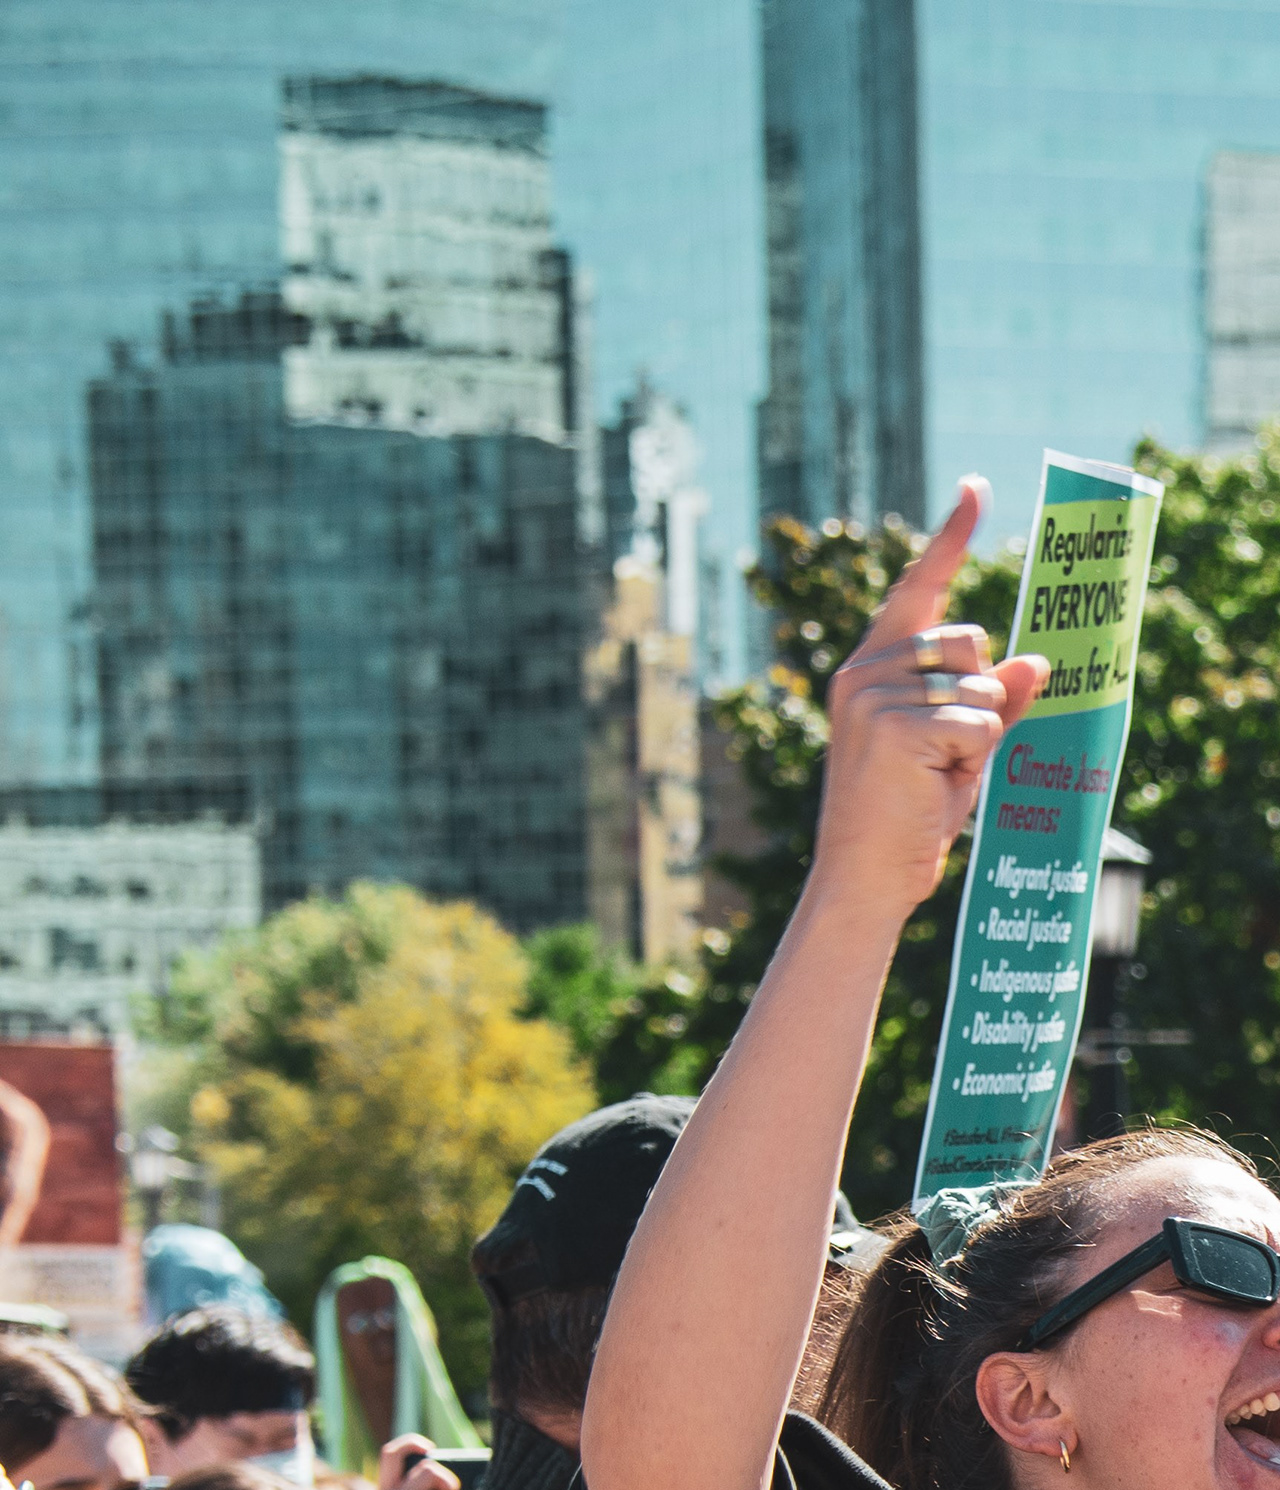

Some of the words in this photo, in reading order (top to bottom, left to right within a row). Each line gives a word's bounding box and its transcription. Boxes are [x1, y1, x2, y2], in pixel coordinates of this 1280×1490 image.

[1030, 580, 1128, 633] EVERYONE
[1086, 646, 1110, 693] for
[1008, 743, 1074, 791] Climate
[997, 803, 1062, 834] means:
[994, 855, 1051, 900] Migrant
[1047, 859, 1088, 901] justice
[986, 907, 1032, 941] Racial
[1026, 910, 1072, 951] justice
[979, 958, 1054, 1003] Indigenous
[971, 1010, 1035, 1053] Disability
[961, 1062, 1027, 1096] Economic
